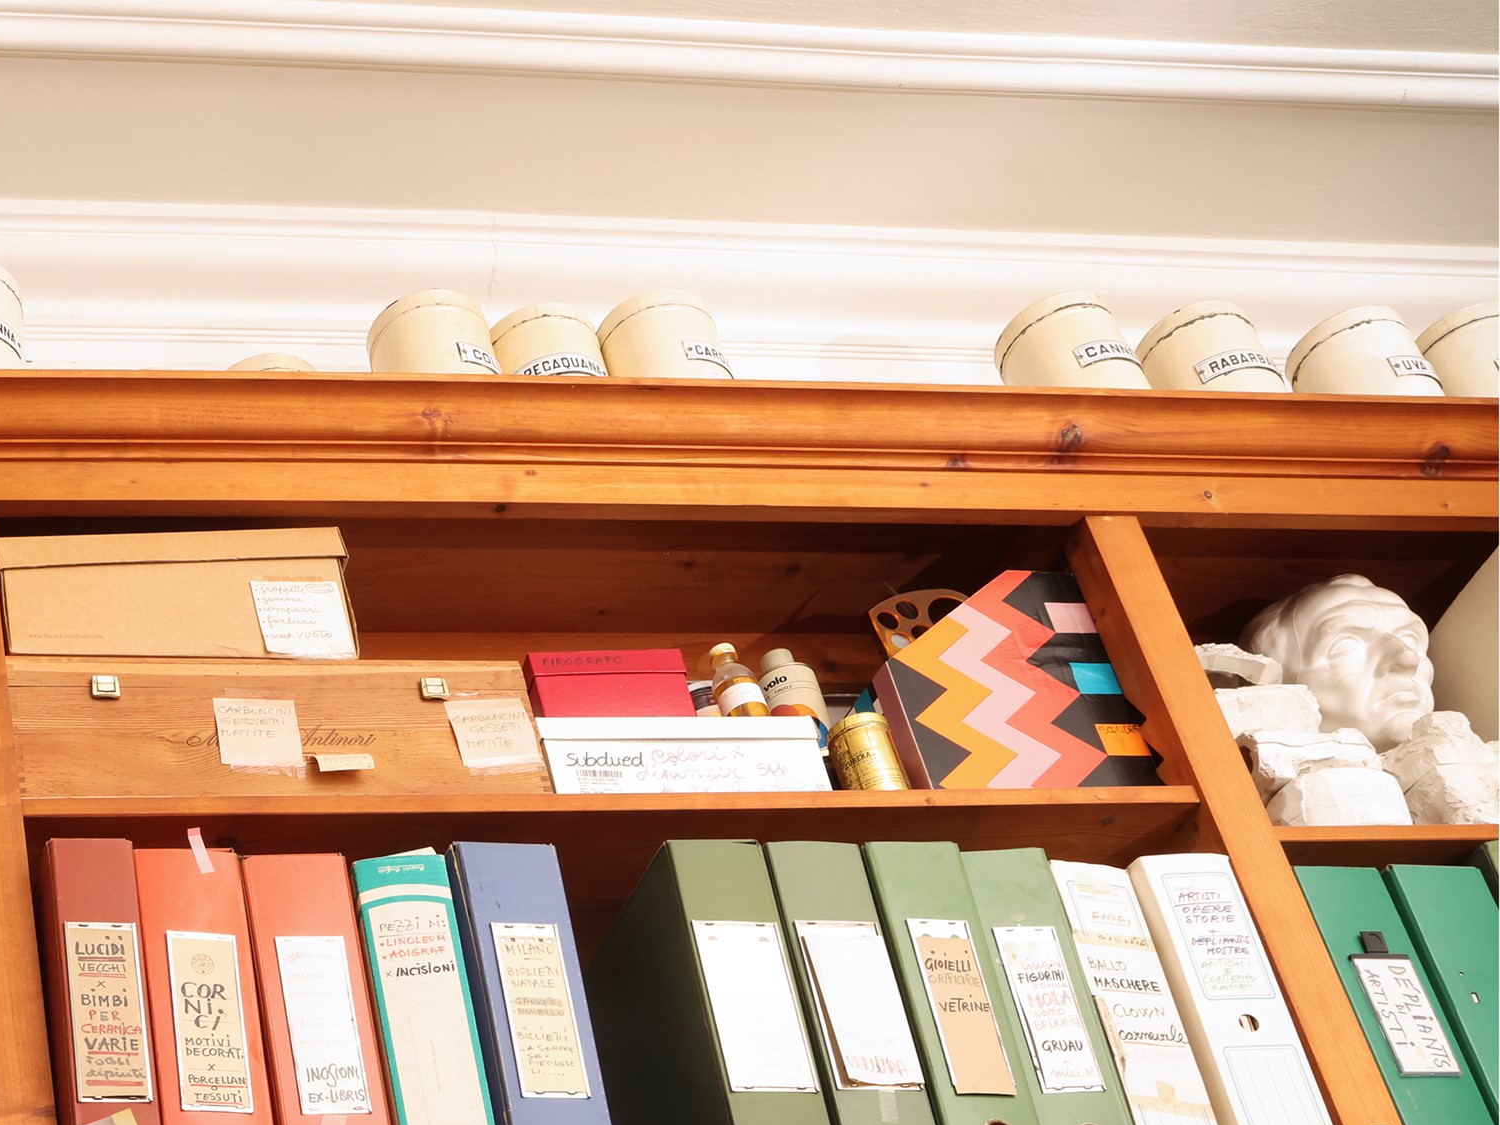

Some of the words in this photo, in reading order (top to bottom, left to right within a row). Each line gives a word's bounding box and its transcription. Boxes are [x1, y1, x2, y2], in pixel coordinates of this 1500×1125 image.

[522, 356, 601, 376] PECAQUANA
[542, 654, 623, 667] PIROGRAFO
[762, 674, 788, 692] volo
[566, 751, 645, 768] Subdued
[1178, 891, 1221, 902] ARTISTI
[1182, 904, 1233, 914] OPERE
[379, 916, 421, 933] PEZZI
[1185, 914, 1236, 924] STORIE
[505, 943, 555, 956] MILANO
[1206, 947, 1250, 955] MOSTRE
[78, 963, 127, 973] VECCHI
[924, 950, 971, 973] GIOIELLI
[1089, 956, 1128, 971] BALLO
[511, 979, 556, 990] NATALE
[1094, 976, 1162, 993] MASCHERE
[938, 995, 990, 1013] VETRINE
[1113, 1002, 1166, 1018] CLOWN
[89, 1010, 121, 1021] PER
[81, 1022, 142, 1036] CERAMICA
[84, 1037, 139, 1052] VARIE
[308, 1088, 366, 1104] EX-LIBRIS
